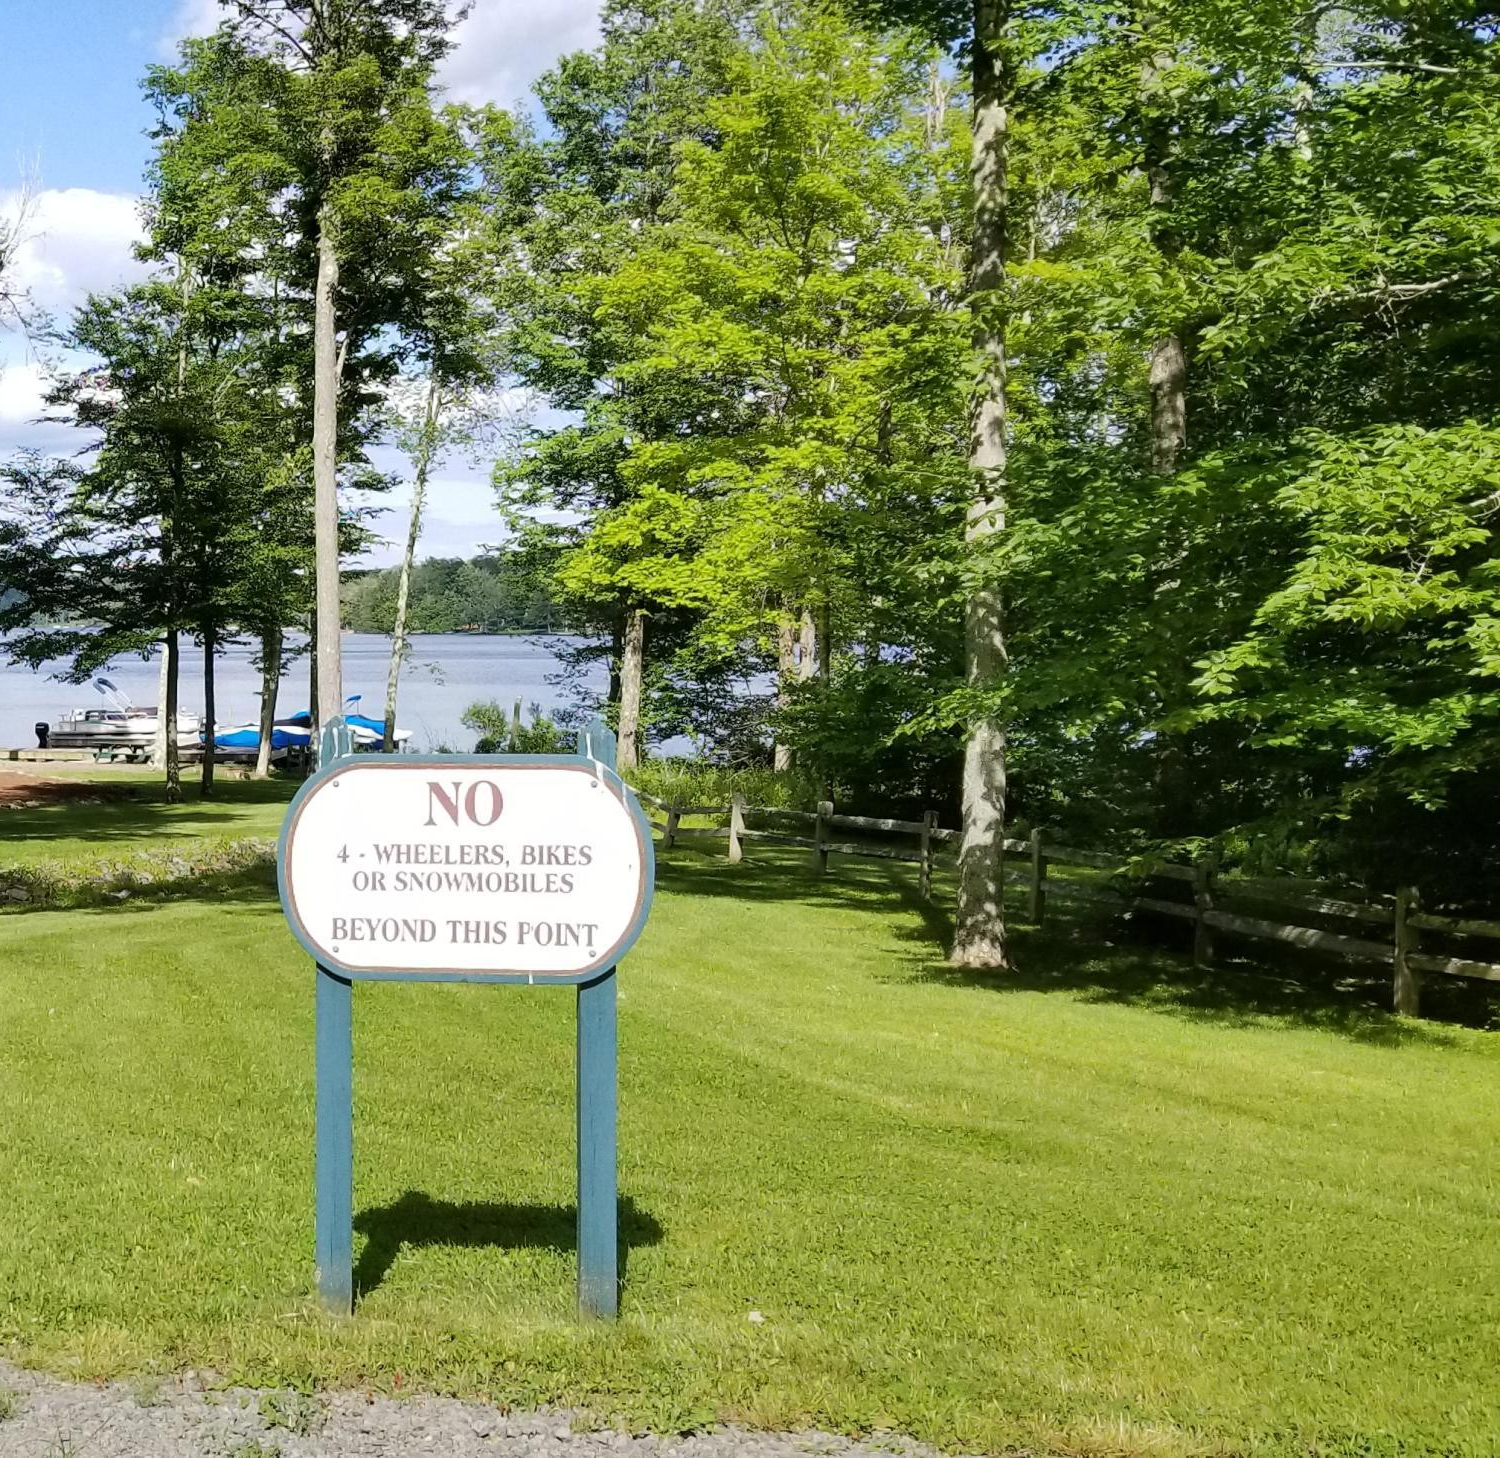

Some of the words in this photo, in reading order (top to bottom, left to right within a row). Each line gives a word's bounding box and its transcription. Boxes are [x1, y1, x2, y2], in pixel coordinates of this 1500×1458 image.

[423, 780, 504, 827] NO
[336, 843, 350, 864] 4
[372, 843, 510, 868] WHEELERS,
[520, 844, 593, 866] BIKES
[352, 870, 387, 892] OR
[393, 870, 575, 894] SNOWMOBILES
[331, 917, 437, 943] BEYOND
[446, 920, 508, 945] THIS
[517, 921, 599, 948] POINT
